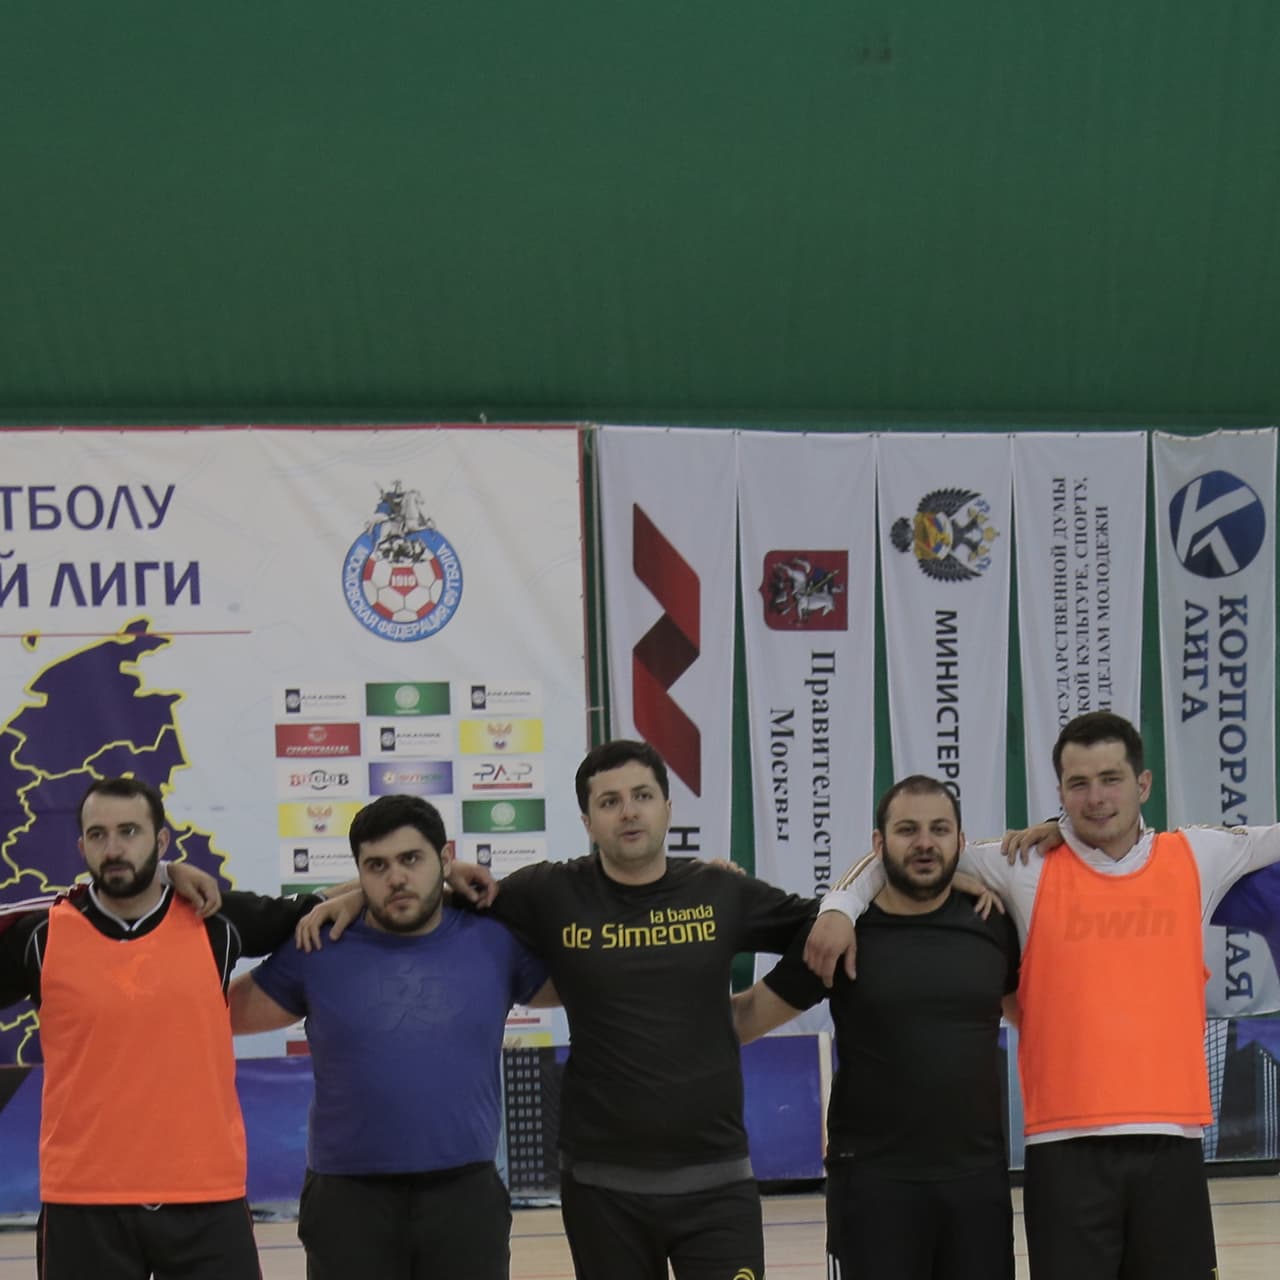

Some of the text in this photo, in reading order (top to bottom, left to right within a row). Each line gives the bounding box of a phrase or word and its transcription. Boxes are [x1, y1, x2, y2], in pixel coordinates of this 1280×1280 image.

[51, 560, 202, 609] ЛИГИ
[1050, 477, 1070, 733] ОСУДАРСТВЕННОЙ ДУМЫ
[1073, 477, 1091, 716] КОЙ КУЛЬТУРЕ, СПОРТУ,
[1095, 505, 1111, 617] МОЛОДЕЖИ
[934, 610, 961, 800] МИНИСТЕРС
[1097, 626, 1112, 696] ДЕЛАМ
[1182, 599, 1209, 723] ЛИГА
[769, 708, 795, 842] Москвы
[804, 650, 836, 899] Правительство
[562, 920, 716, 949] de Simeone
[650, 904, 714, 924] la banda
